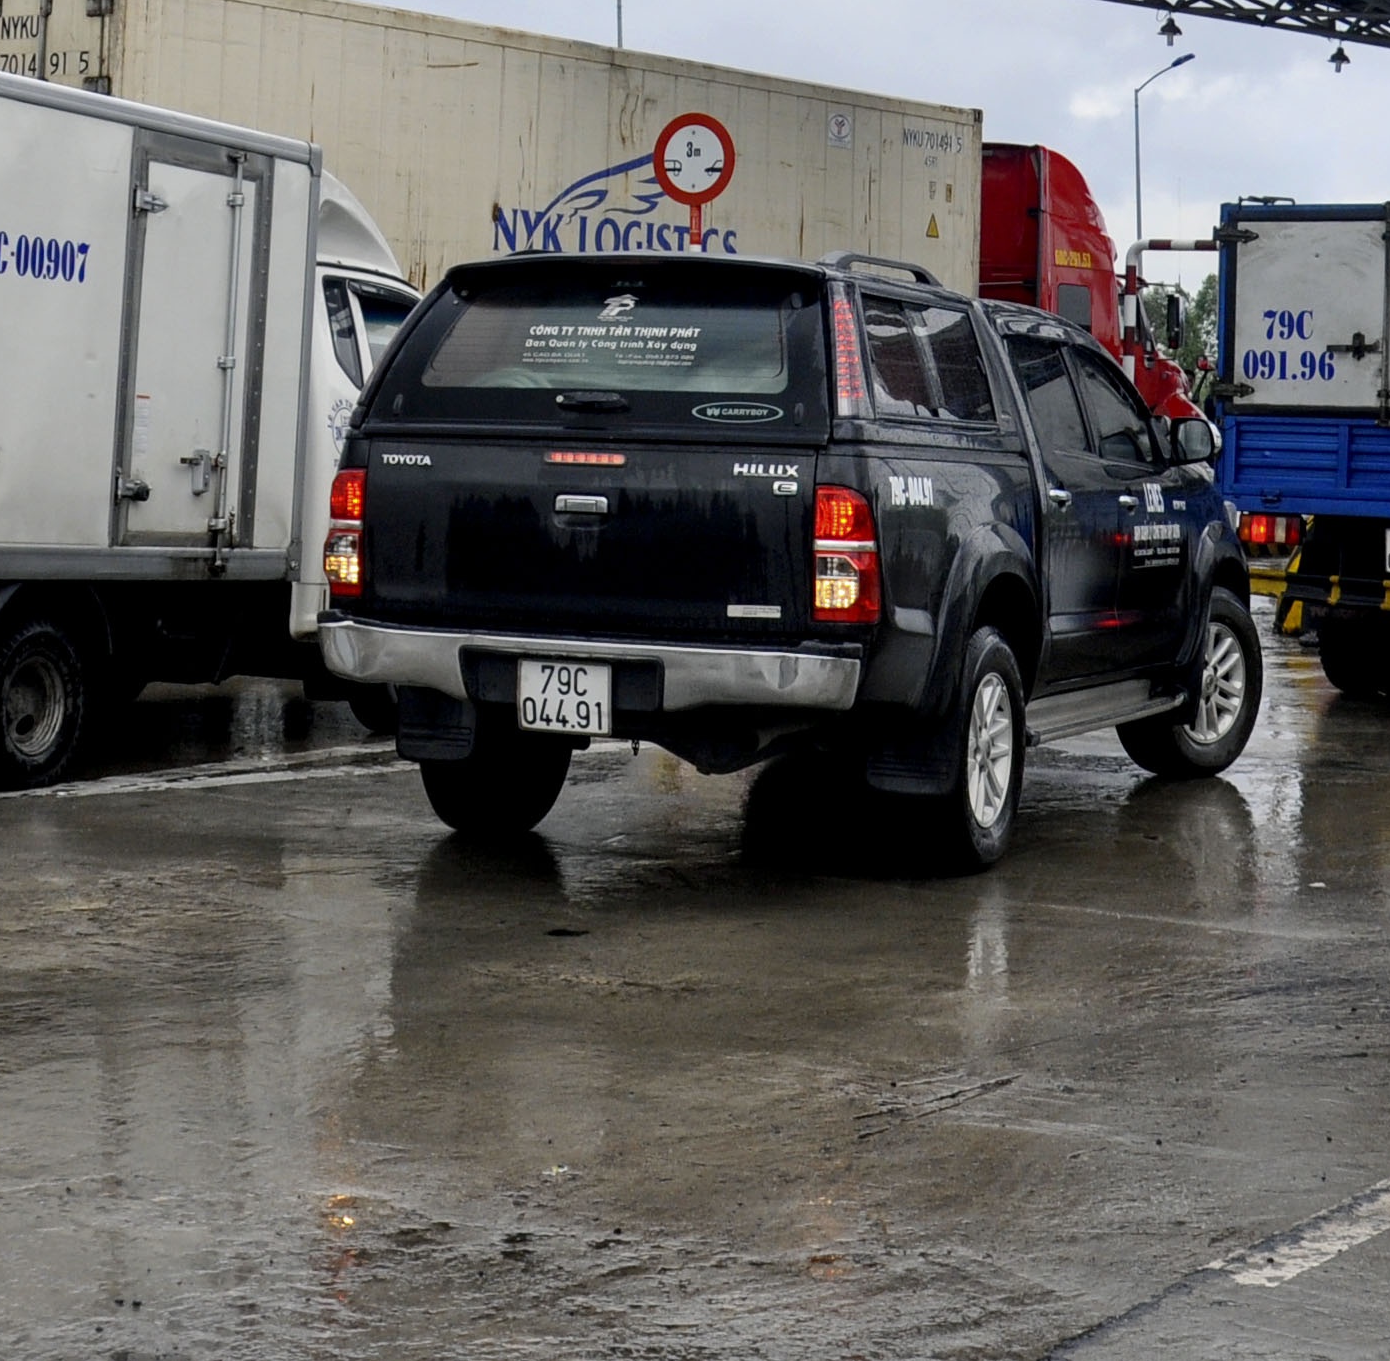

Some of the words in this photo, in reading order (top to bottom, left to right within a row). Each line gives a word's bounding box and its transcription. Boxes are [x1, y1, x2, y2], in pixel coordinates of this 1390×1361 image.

[1, 15, 40, 40] NYKU
[902, 128, 924, 147] NYKU
[493, 206, 563, 252] NYK
[578, 215, 738, 254] LOGISTCS
[529, 324, 559, 337] CÔNG
[561, 326, 575, 336] TY
[577, 326, 607, 337] TNHH
[634, 326, 668, 339] THỊNH
[670, 326, 701, 338] PHÁT
[1263, 309, 1313, 340] 79C
[525, 339, 545, 348] Ban
[1243, 349, 1335, 381] 091.96
[721, 408, 769, 416] CARRYBOY
[381, 453, 432, 466] TOYOTA
[733, 462, 800, 478] HILUX
[541, 664, 588, 696] 79C
[522, 696, 603, 731] 044.91
